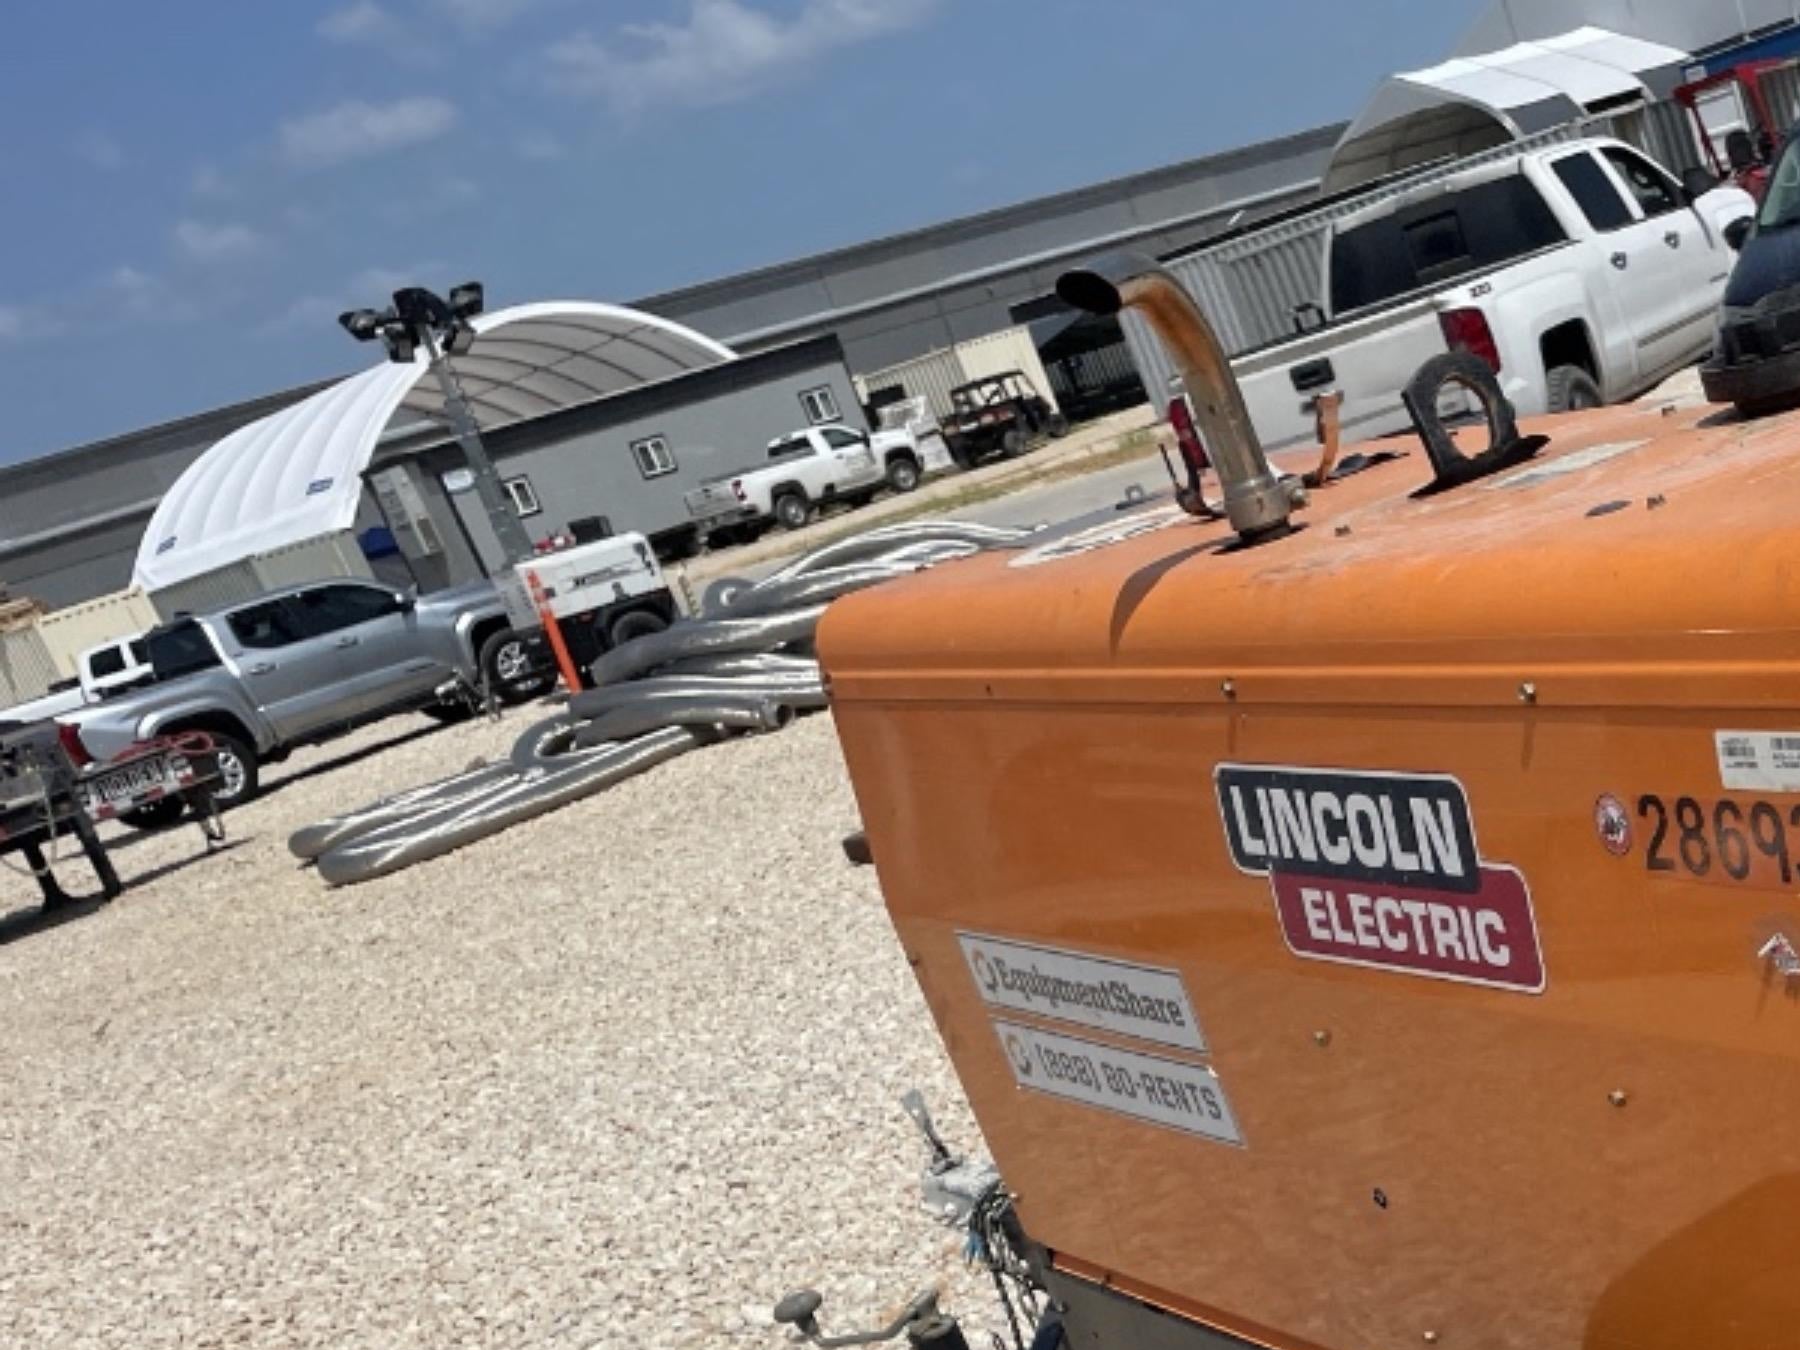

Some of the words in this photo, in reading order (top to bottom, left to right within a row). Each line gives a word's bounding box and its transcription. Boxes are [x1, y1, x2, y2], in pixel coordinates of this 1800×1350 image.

[1229, 785, 1465, 878] LINCOLN
[1300, 887, 1511, 967] ELECTRIC
[993, 956, 1187, 1027] EquipmentShare
